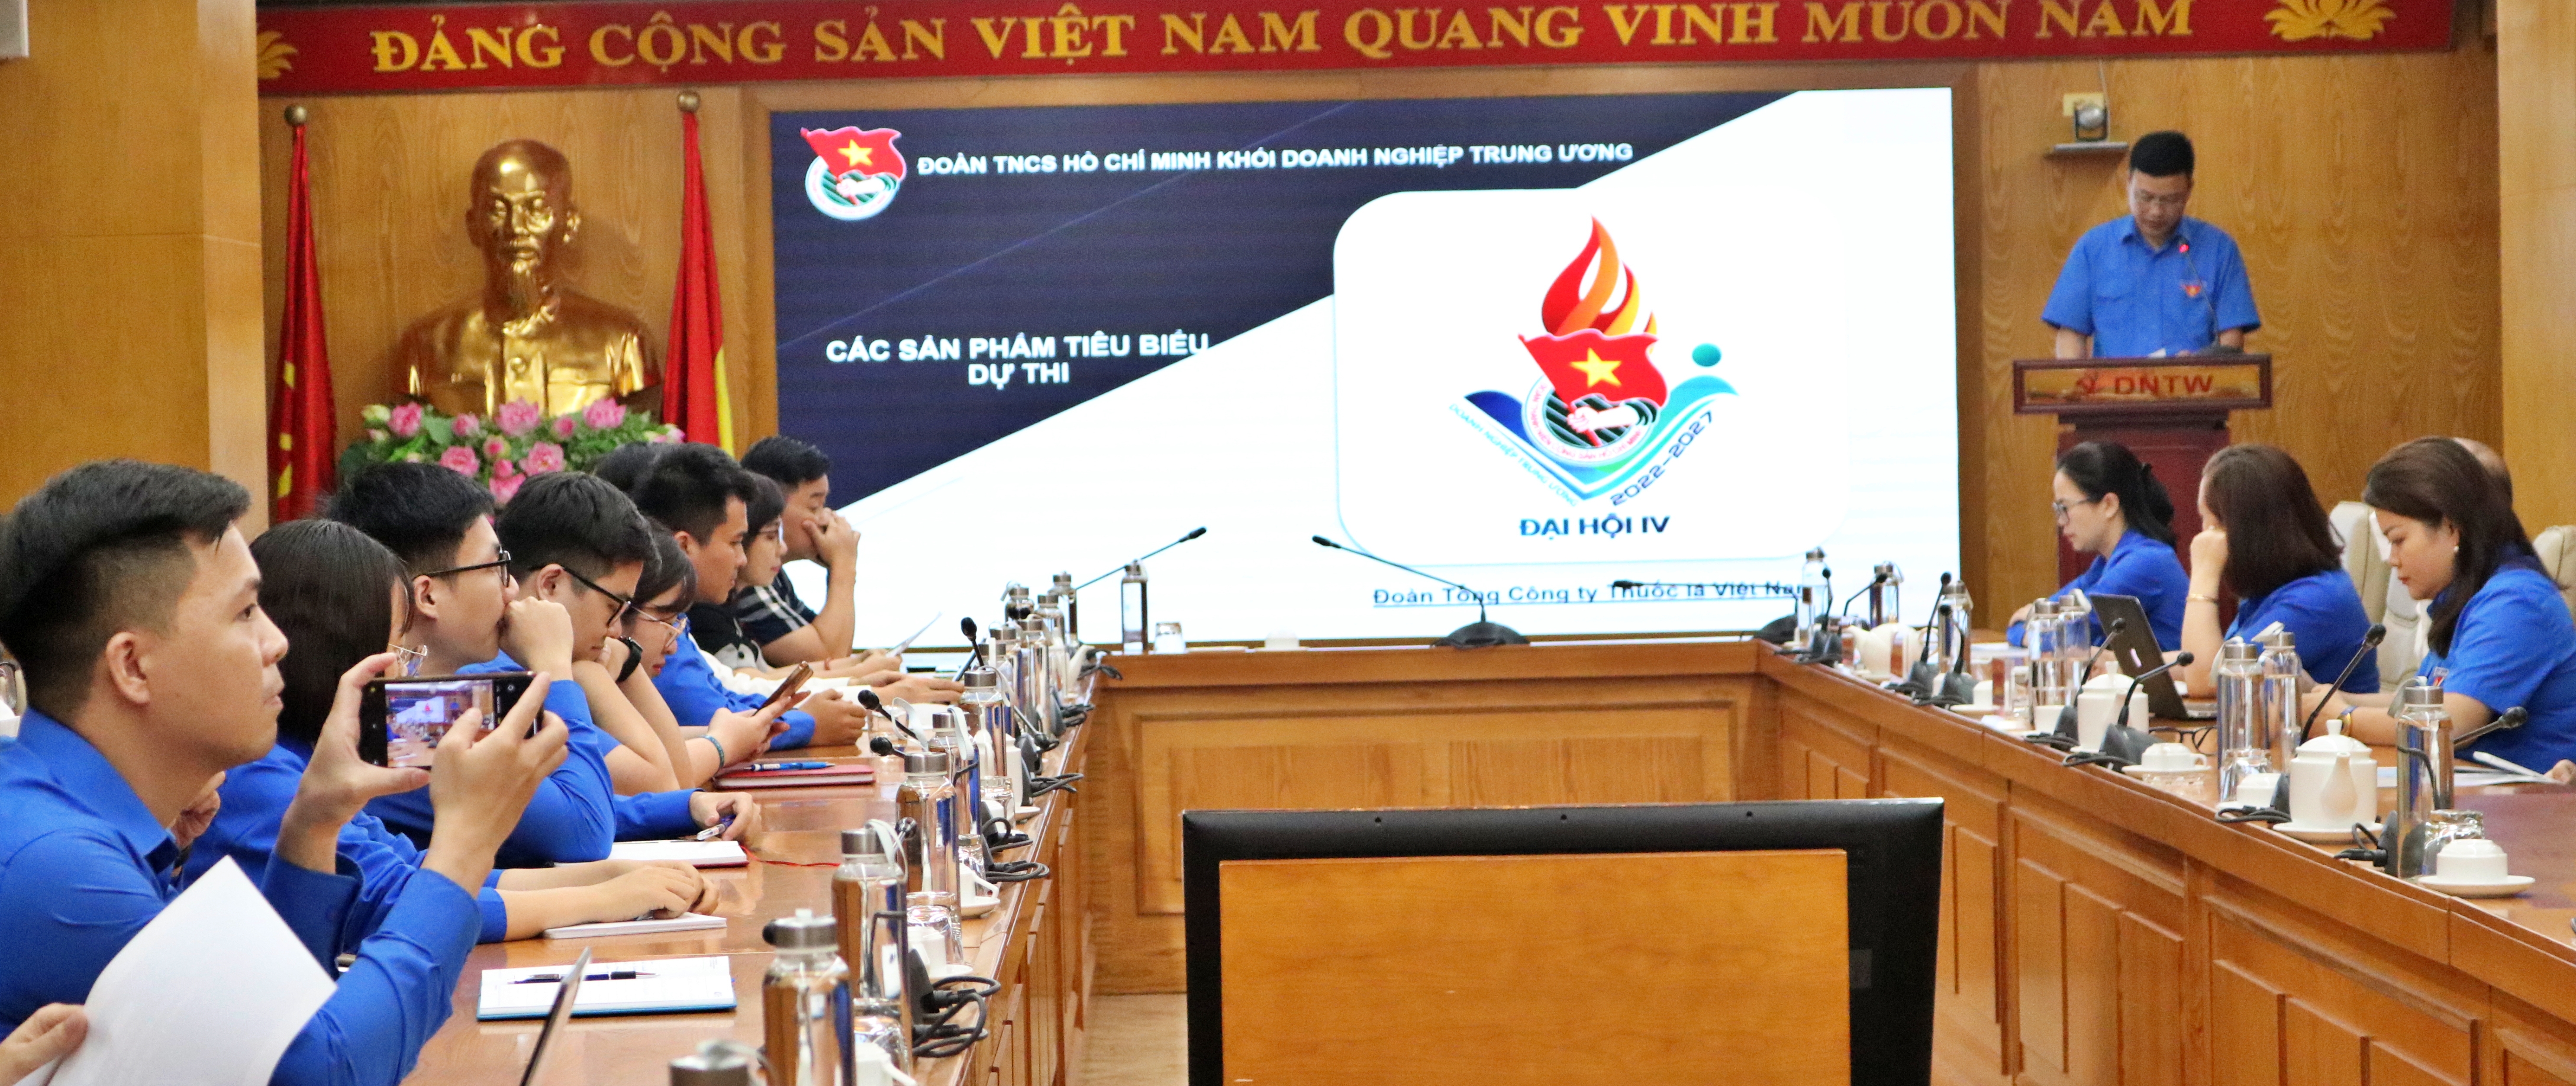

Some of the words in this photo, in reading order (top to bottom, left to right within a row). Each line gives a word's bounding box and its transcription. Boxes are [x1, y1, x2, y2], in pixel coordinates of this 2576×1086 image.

[370, 14, 566, 72] ĐẢNG
[589, 10, 787, 73] CỘNG
[814, 6, 946, 63] SẢN
[970, 3, 1134, 66] VIỆT
[1161, 10, 1321, 55] NAM
[1344, 6, 1583, 59] QUANG
[1603, 3, 1778, 45] VINH
[917, 152, 987, 175] ĐOÀN
[993, 155, 1057, 174] TNCS
[1104, 148, 1145, 171] CHÍ
[1151, 151, 1211, 171] MINH
[1282, 148, 1367, 168] DOANH
[1374, 144, 1464, 169] NGHIỆP
[1469, 145, 1553, 164] TRUNG
[1558, 143, 1633, 162] ƯƠNG
[826, 335, 890, 363] CÁC
[899, 335, 960, 361] SẢN
[1063, 330, 1131, 358] TIÊU
[968, 363, 1015, 390] DỰ
[1022, 362, 1069, 384] THI
[1610, 410, 1712, 506] 2022-2027
[1519, 518, 1569, 540] ĐẠI
[1579, 512, 1631, 538] HỘI
[1642, 516, 1670, 533] IV
[1373, 589, 1433, 604] Đoàn
[1509, 586, 1569, 604] Công
[1578, 587, 1598, 603] ty
